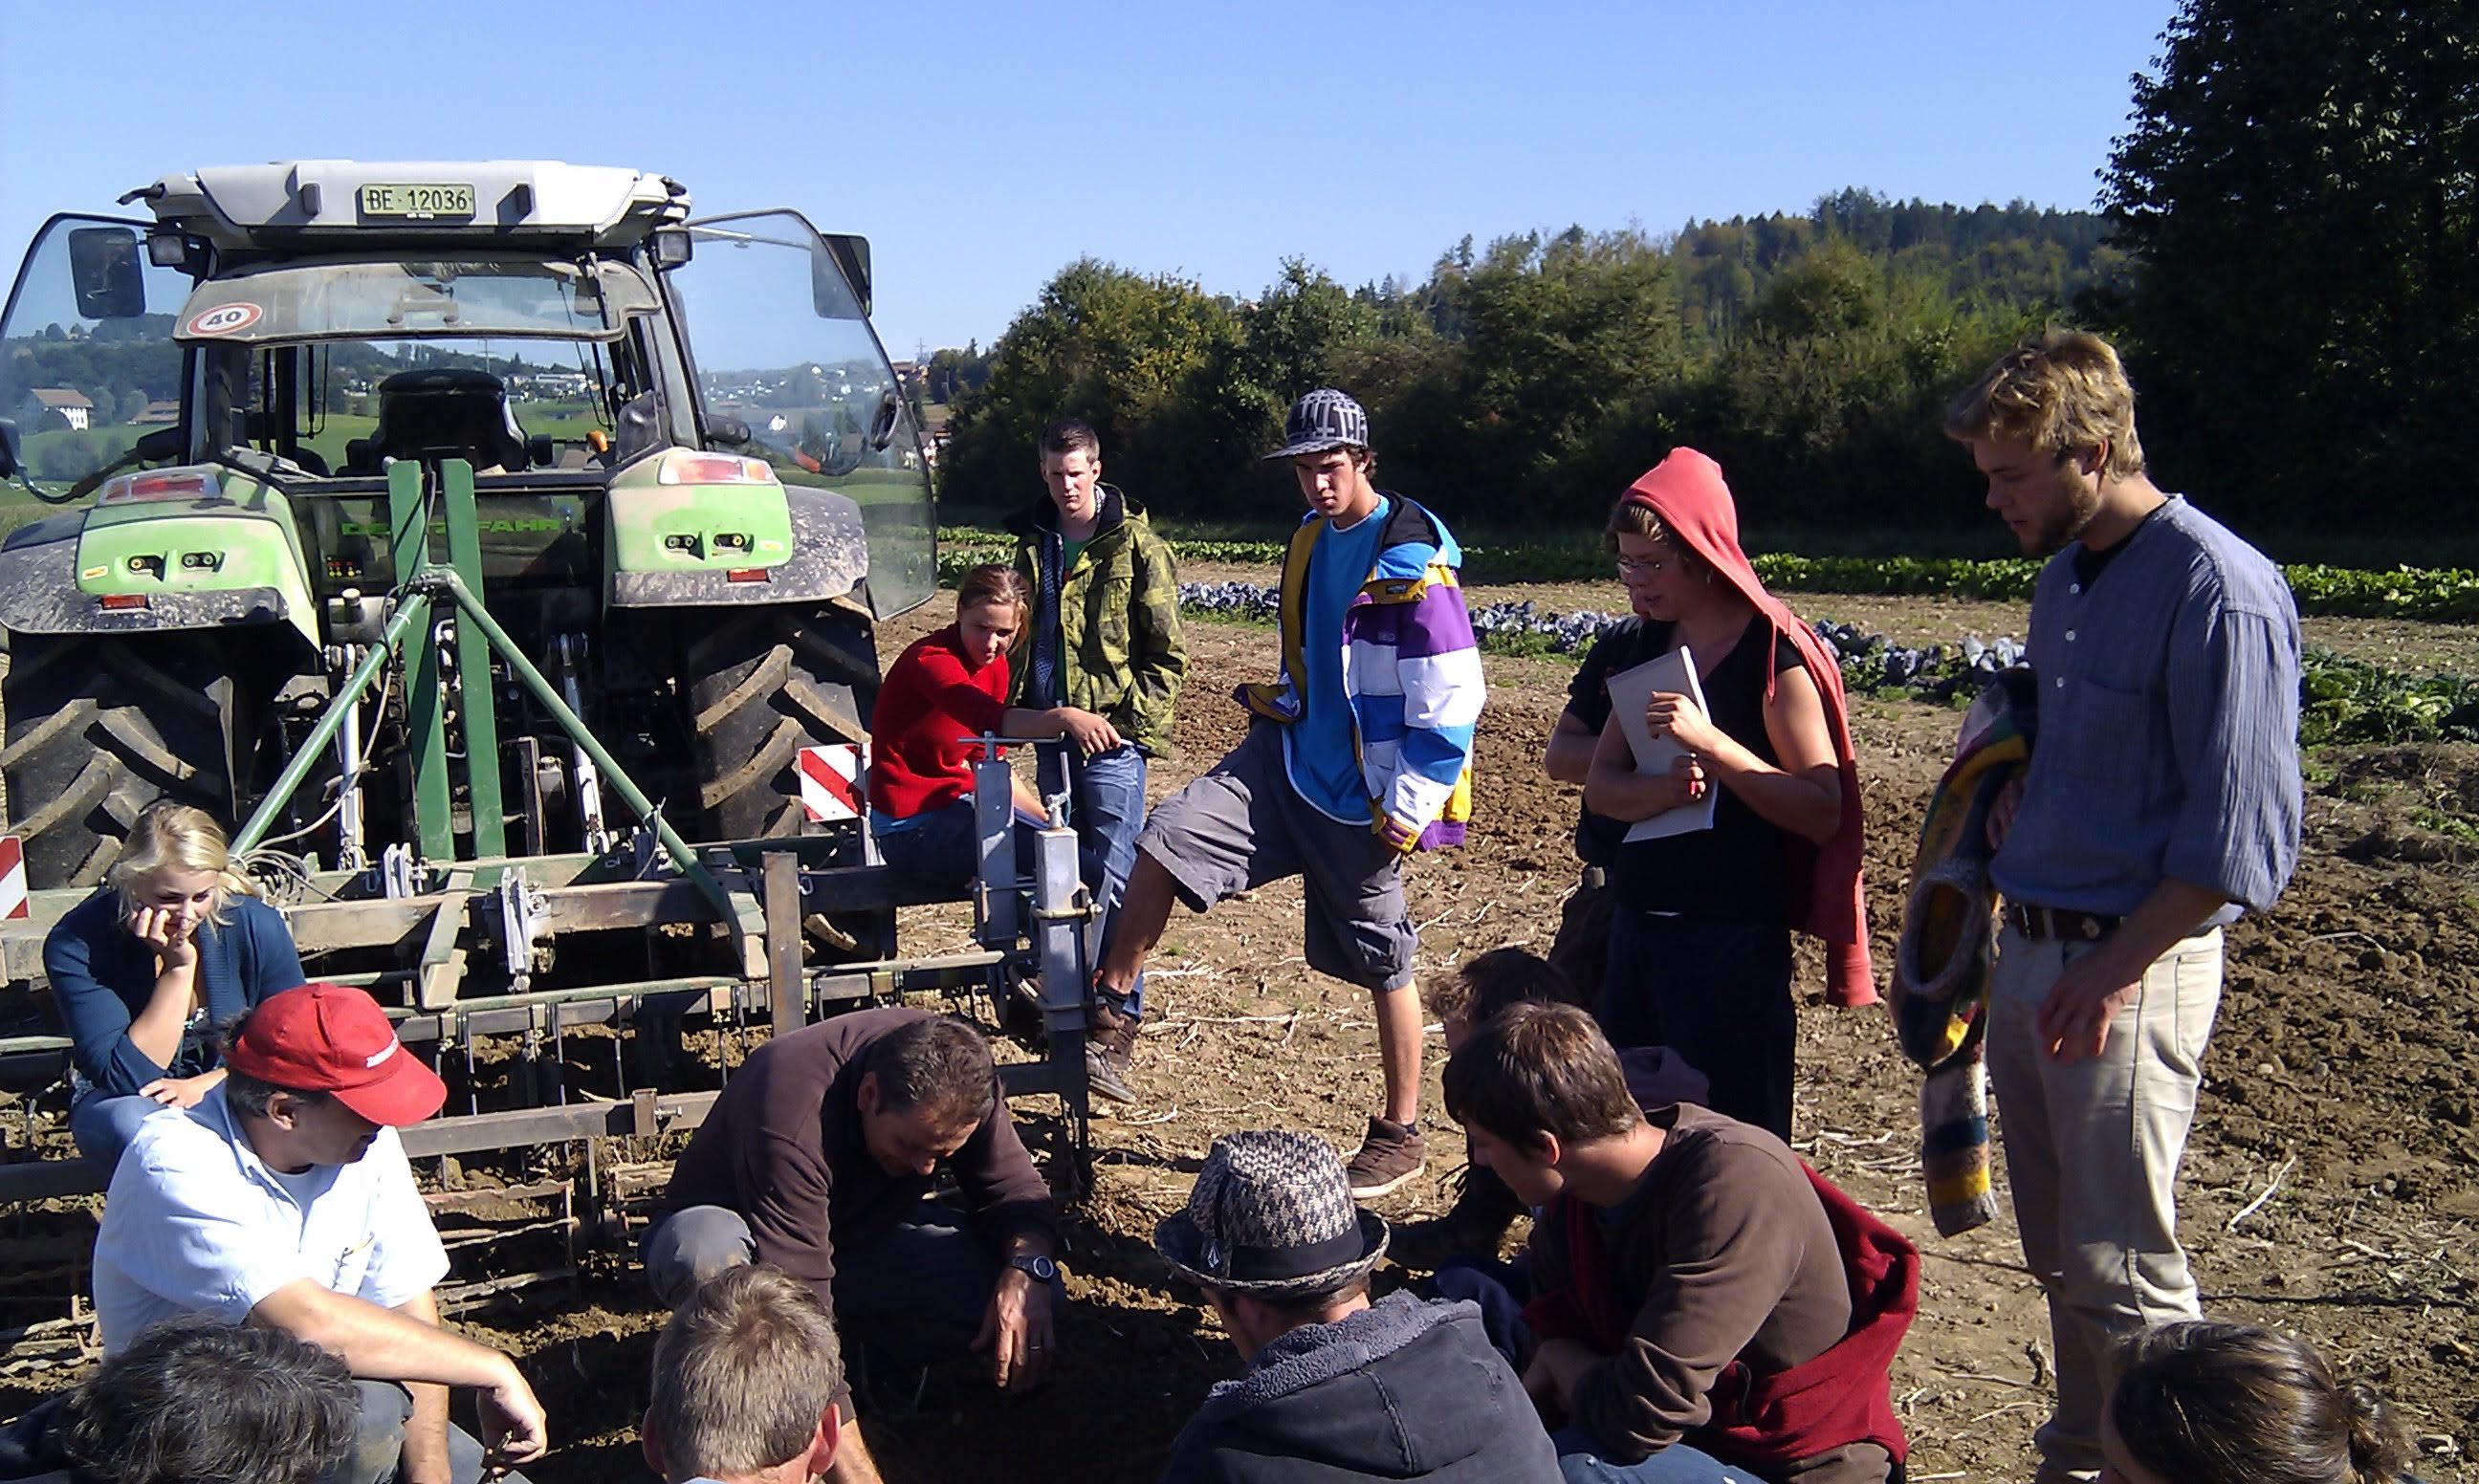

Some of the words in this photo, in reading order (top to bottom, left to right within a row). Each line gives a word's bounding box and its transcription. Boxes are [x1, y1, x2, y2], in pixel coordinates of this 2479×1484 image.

[368, 189, 394, 210] BE
[407, 189, 467, 210] 12036
[206, 311, 242, 325] 40
